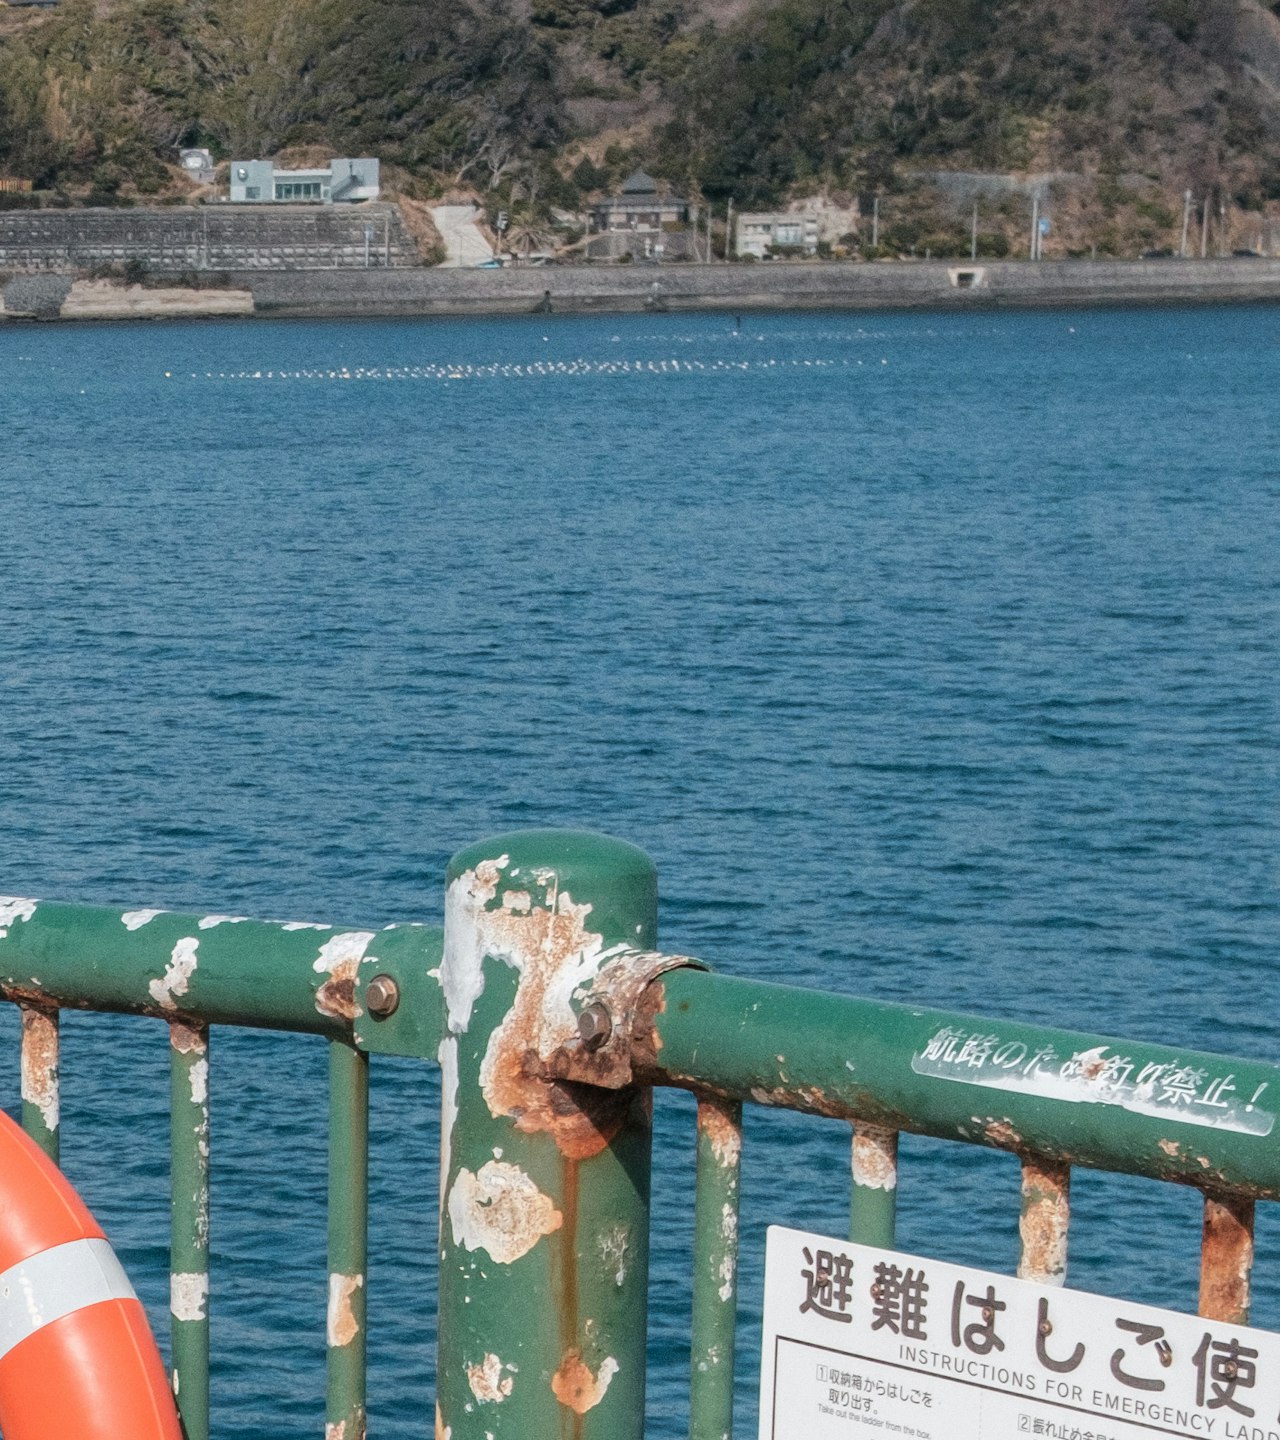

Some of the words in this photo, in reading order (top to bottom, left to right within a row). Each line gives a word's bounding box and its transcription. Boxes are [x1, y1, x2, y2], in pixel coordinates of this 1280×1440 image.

[799, 1246, 1280, 1425] 避難はしご使
[828, 1388, 878, 1415] 取り出す。
[829, 1368, 933, 1408] 収納箱からはしごを
[899, 1345, 1036, 1391] INSTRUCTIONS
[1045, 1379, 1083, 1402] FOR
[1092, 1390, 1216, 1433] EMERGENCY
[818, 1403, 834, 1415] Take
[835, 1408, 847, 1420] out
[848, 1411, 860, 1422] the
[861, 1414, 884, 1428] ladder
[885, 1420, 901, 1432] from
[903, 1425, 915, 1436] the
